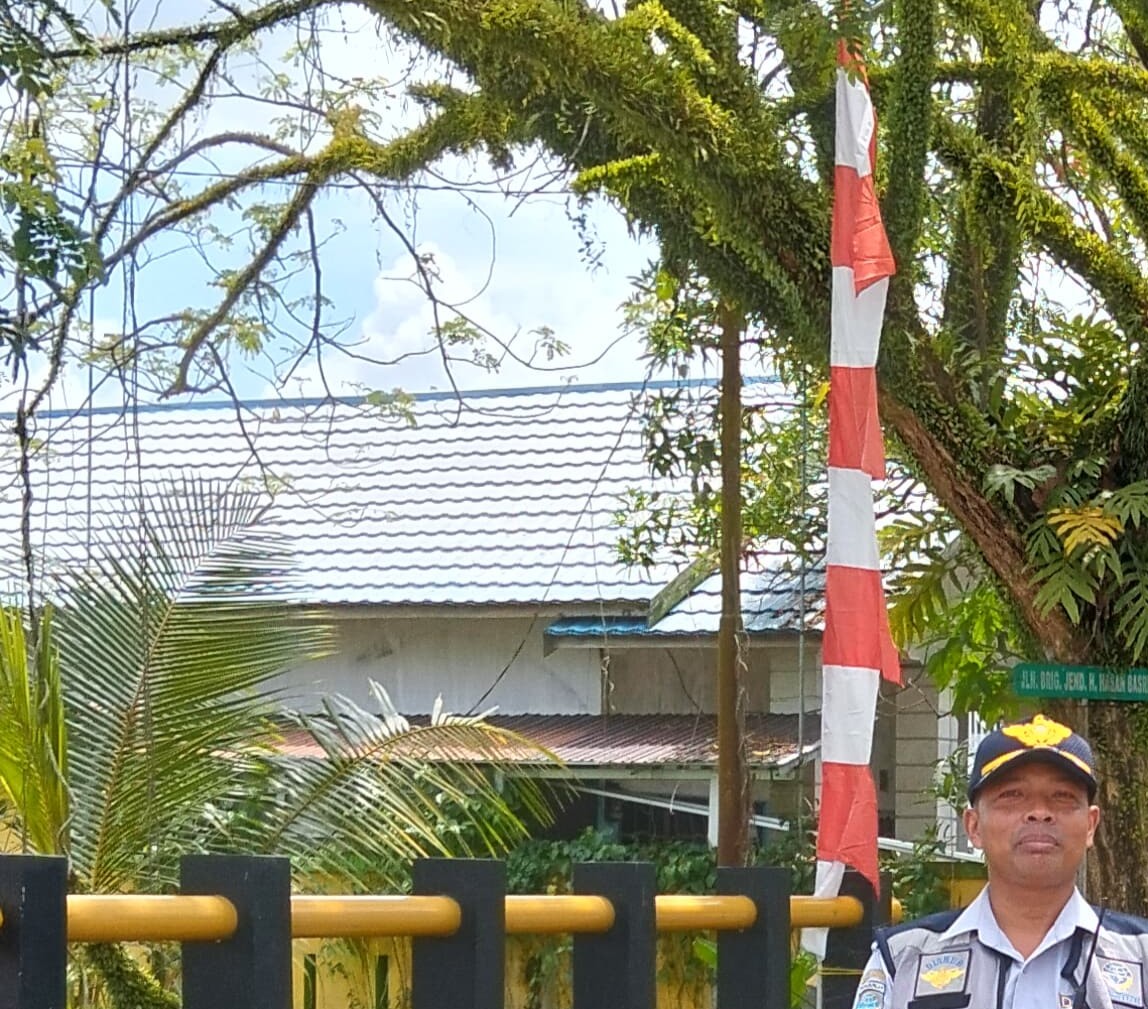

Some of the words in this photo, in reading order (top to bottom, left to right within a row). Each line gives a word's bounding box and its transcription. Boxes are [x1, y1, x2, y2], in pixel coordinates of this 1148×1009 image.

[1021, 670, 1039, 689] JLN.
[1041, 671, 1062, 690] BRIG.
[1064, 672, 1087, 691] JEND.
